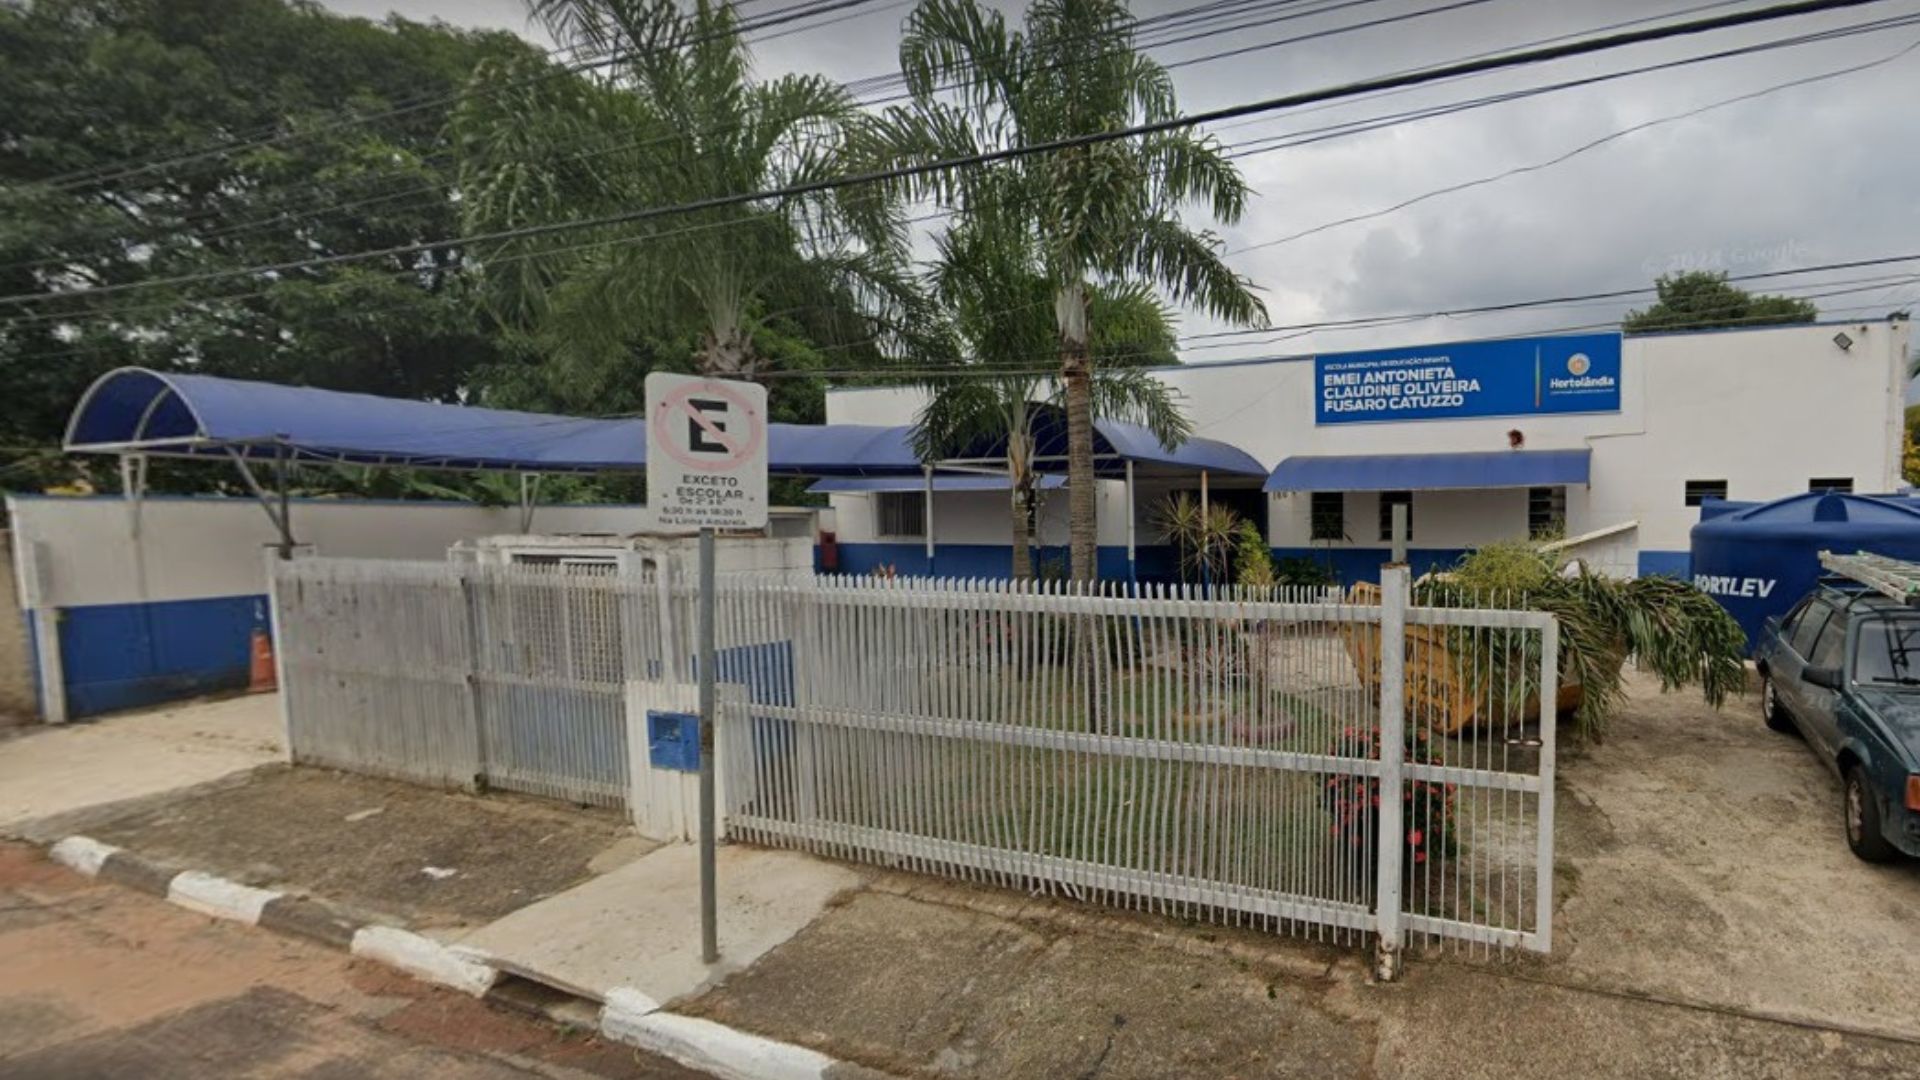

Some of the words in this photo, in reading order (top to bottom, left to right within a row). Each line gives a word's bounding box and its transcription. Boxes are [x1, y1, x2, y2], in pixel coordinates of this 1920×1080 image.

[1324, 372, 1360, 387] EMEI
[1363, 366, 1456, 384] ANTONIETA
[1551, 375, 1615, 389] Hortolândia
[1324, 383, 1401, 400] CLAUDINE
[1403, 378, 1481, 396] OLIVEIRA
[1324, 398, 1387, 413] FUSARO
[1389, 393, 1464, 410] CATUZZO
[682, 474, 738, 487] EXCETO
[676, 486, 744, 499] ESCOLAR
